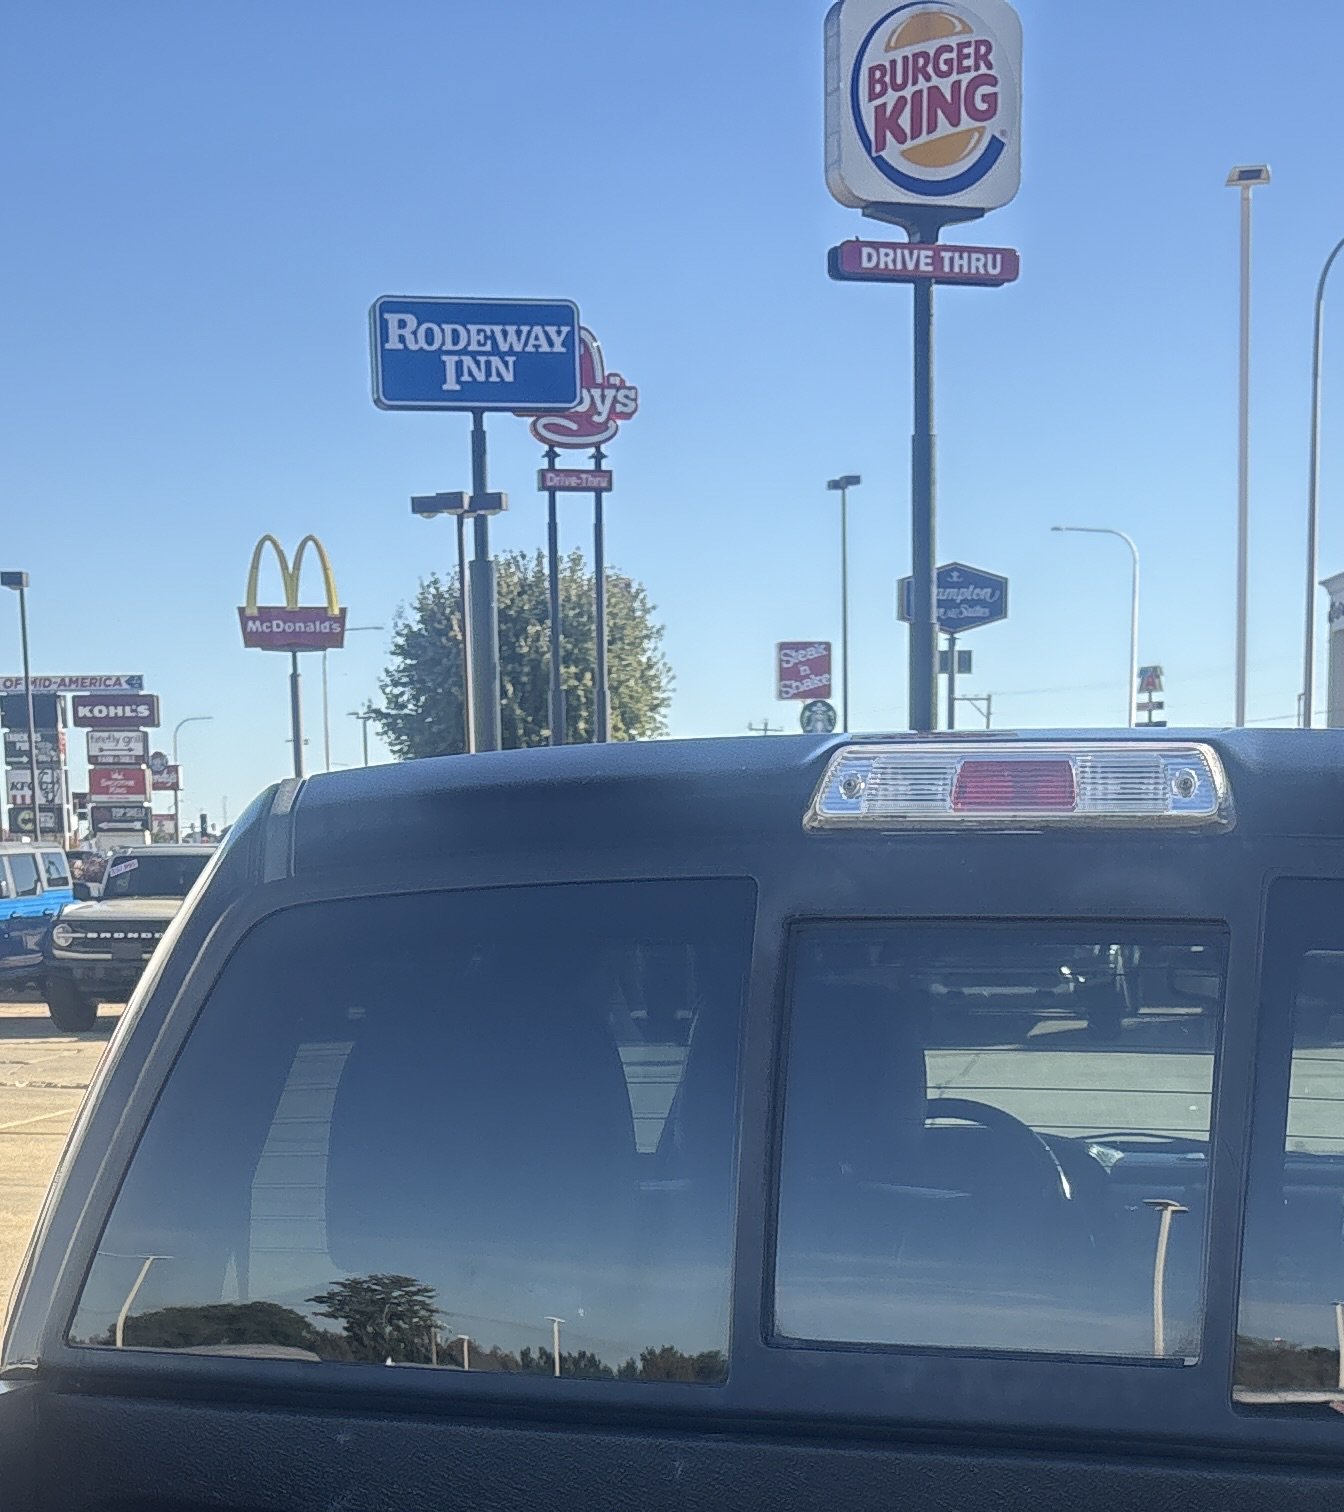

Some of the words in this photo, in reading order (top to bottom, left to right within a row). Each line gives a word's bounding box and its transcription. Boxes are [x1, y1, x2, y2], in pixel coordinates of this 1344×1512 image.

[868, 39, 994, 102] BURGER
[873, 74, 999, 155] KING
[860, 247, 934, 272] DRIVE
[940, 250, 1002, 276] THRU
[384, 312, 571, 353] RODEWAY
[441, 354, 516, 391] INN
[545, 472, 609, 487] Drive-Thru
[936, 584, 1001, 603] ampton
[246, 619, 342, 633] McDonald's
[781, 644, 829, 668] Steak
[2, 677, 23, 690] OF
[29, 676, 124, 690] MID-AMERICA
[781, 673, 831, 698] Shake
[77, 705, 151, 718] KOHL'S
